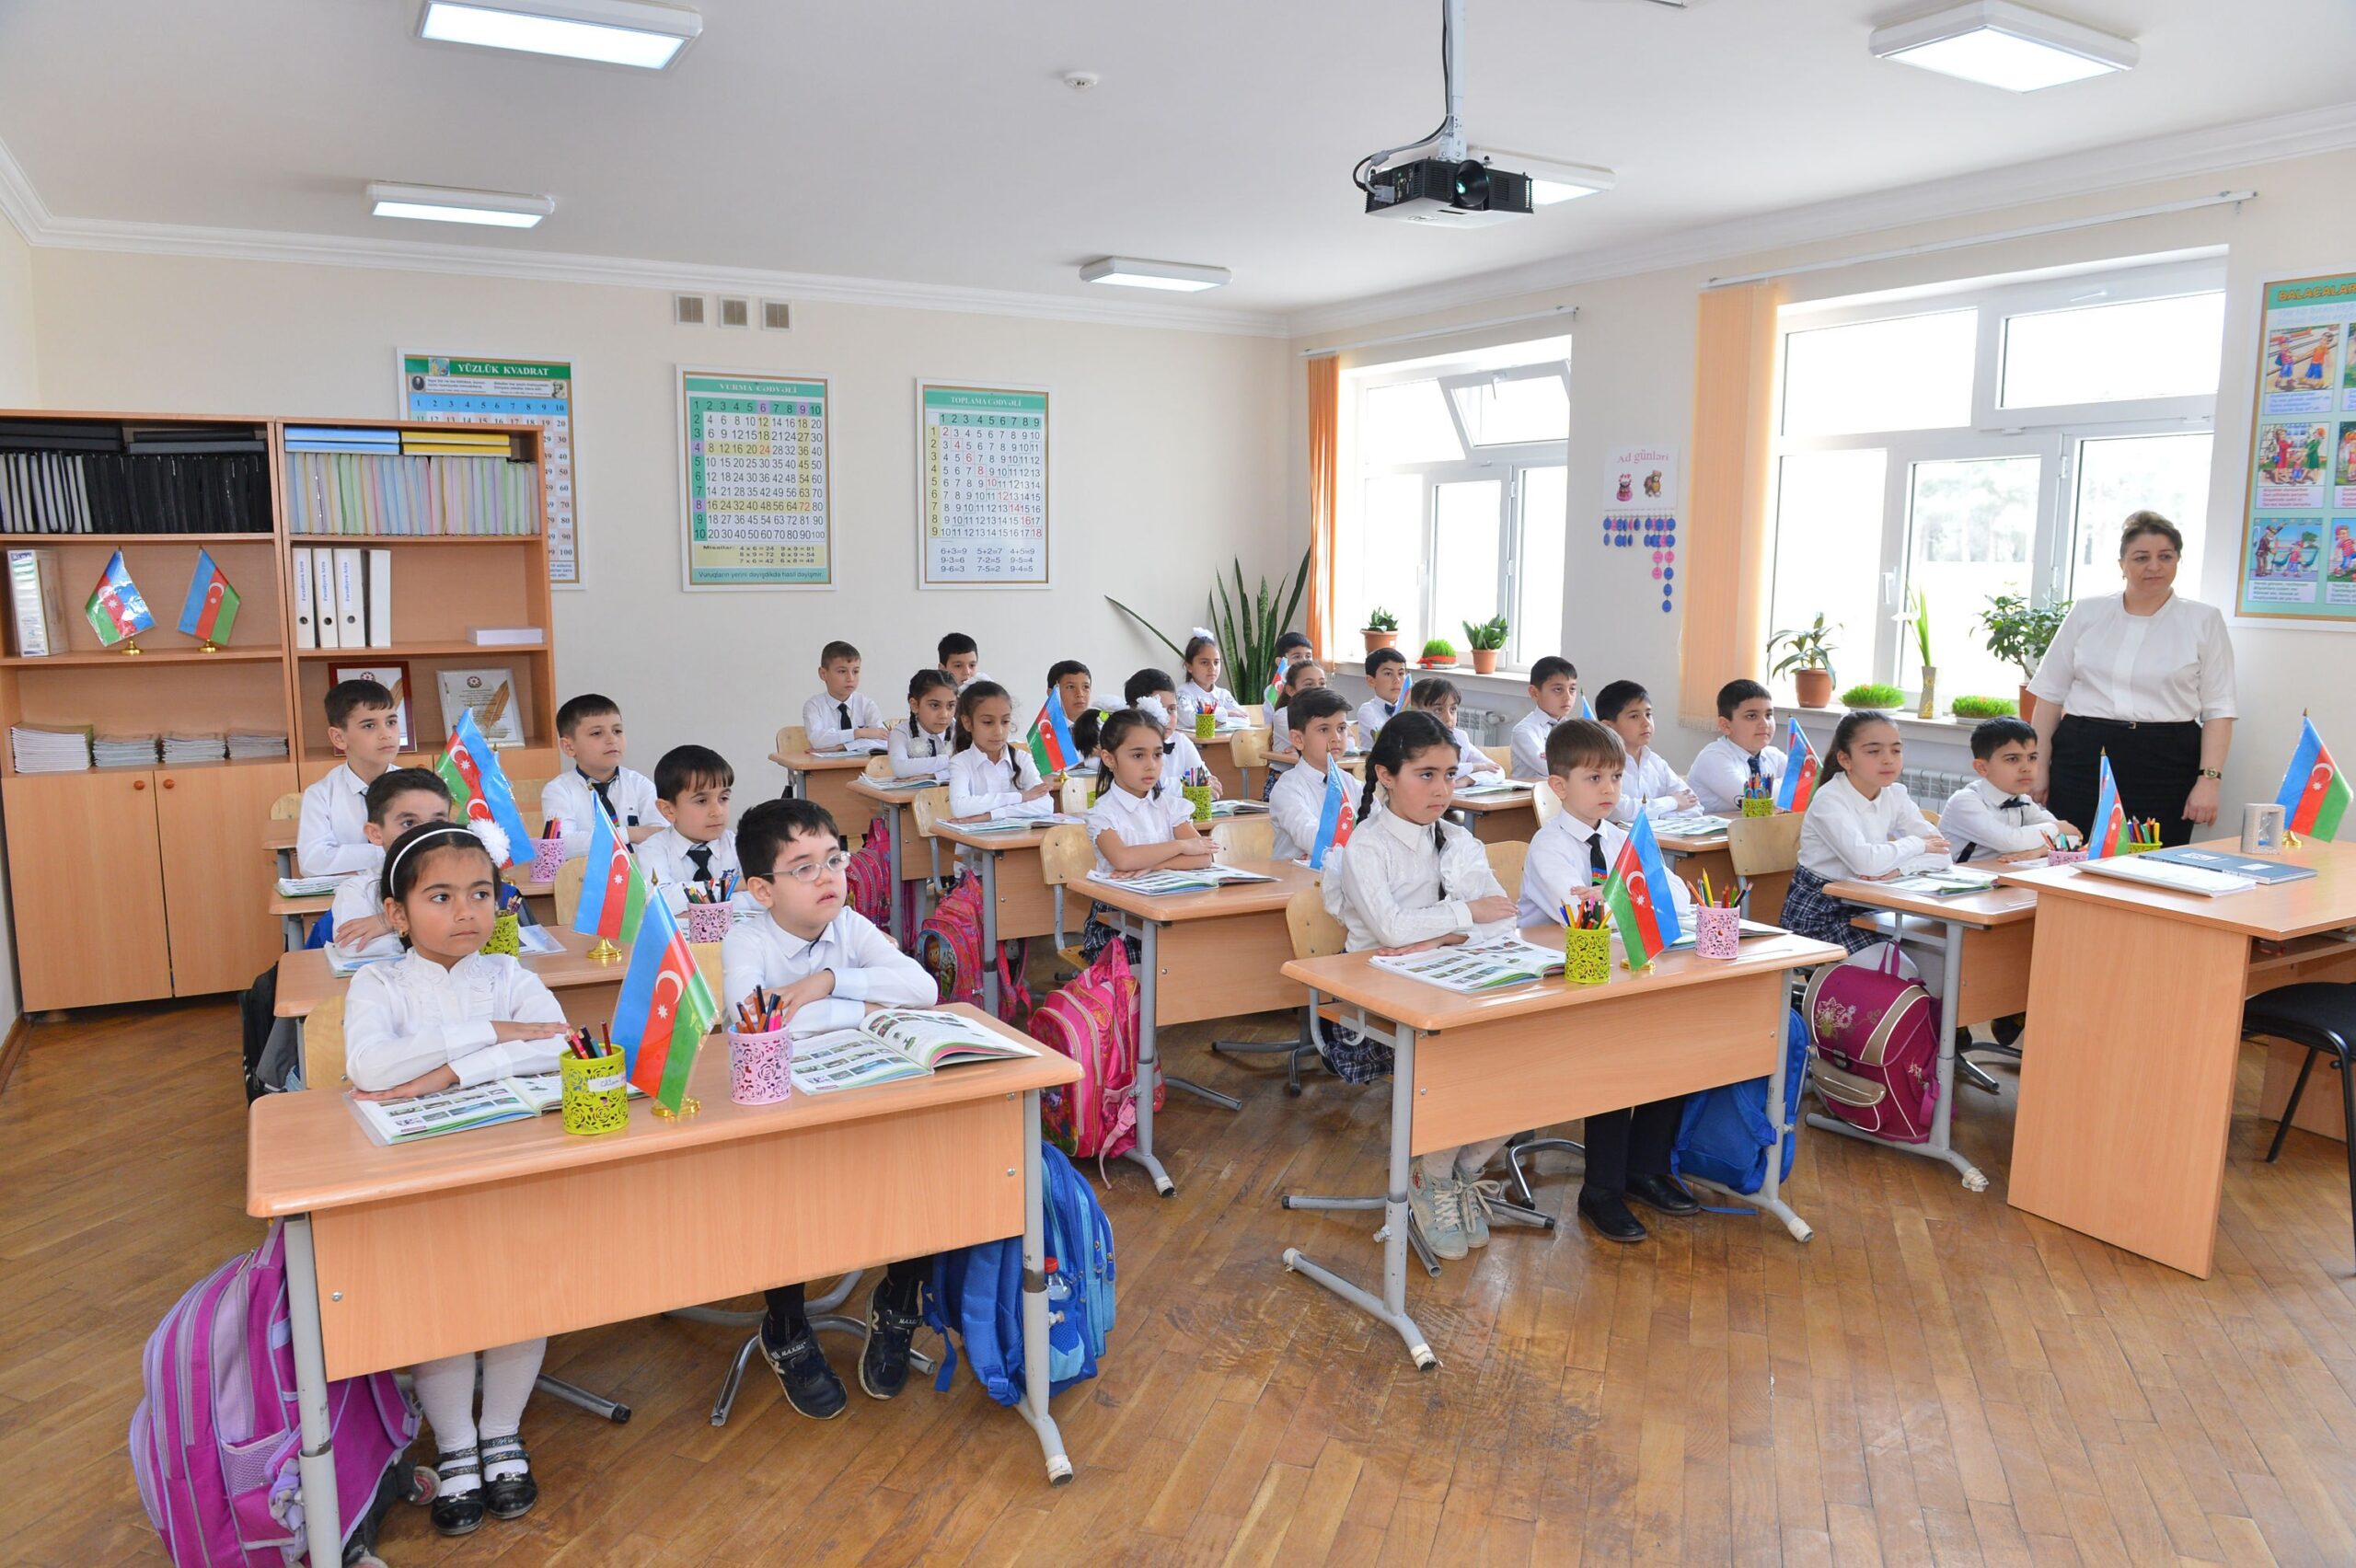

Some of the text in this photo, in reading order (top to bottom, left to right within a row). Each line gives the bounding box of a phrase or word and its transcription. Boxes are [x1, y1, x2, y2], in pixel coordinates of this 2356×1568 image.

[458, 363, 549, 376] YÜZLÜK KVADRAT
[951, 397, 987, 405] TOPLAMA
[695, 401, 821, 415] 1 2 3 4 5 6 7 8 9 10
[694, 414, 822, 429] 2 4 6 8 10 12 14 16 18 20
[941, 414, 944, 422] 1
[952, 414, 957, 423] 2
[963, 415, 969, 424] 3
[989, 416, 994, 425] 5
[1000, 417, 1006, 425] 6
[1012, 417, 1017, 426] 7
[1023, 418, 1028, 426] 8
[1034, 418, 1039, 427] 9
[694, 428, 823, 442] 3 6 9 12 15 18 21 24 27 30
[932, 427, 935, 435] 1
[943, 427, 948, 436] 2
[954, 429, 959, 437] 3
[977, 430, 982, 438] 5
[695, 443, 822, 456] 4 8 12 16 20 24 28 32 36 40
[931, 439, 936, 448] 2
[943, 441, 948, 449] 3
[955, 441, 960, 449] 4
[966, 442, 971, 450] 5
[695, 457, 822, 469] 5 10 15 20 25 30 35 40 45 50
[931, 452, 937, 460] 3
[955, 454, 960, 462] 5
[966, 453, 972, 462] 6
[989, 455, 994, 463] 8
[1617, 449, 1669, 464] Ad günləri
[695, 471, 822, 484] 6 12 18 24 30 36 42 48 54 60
